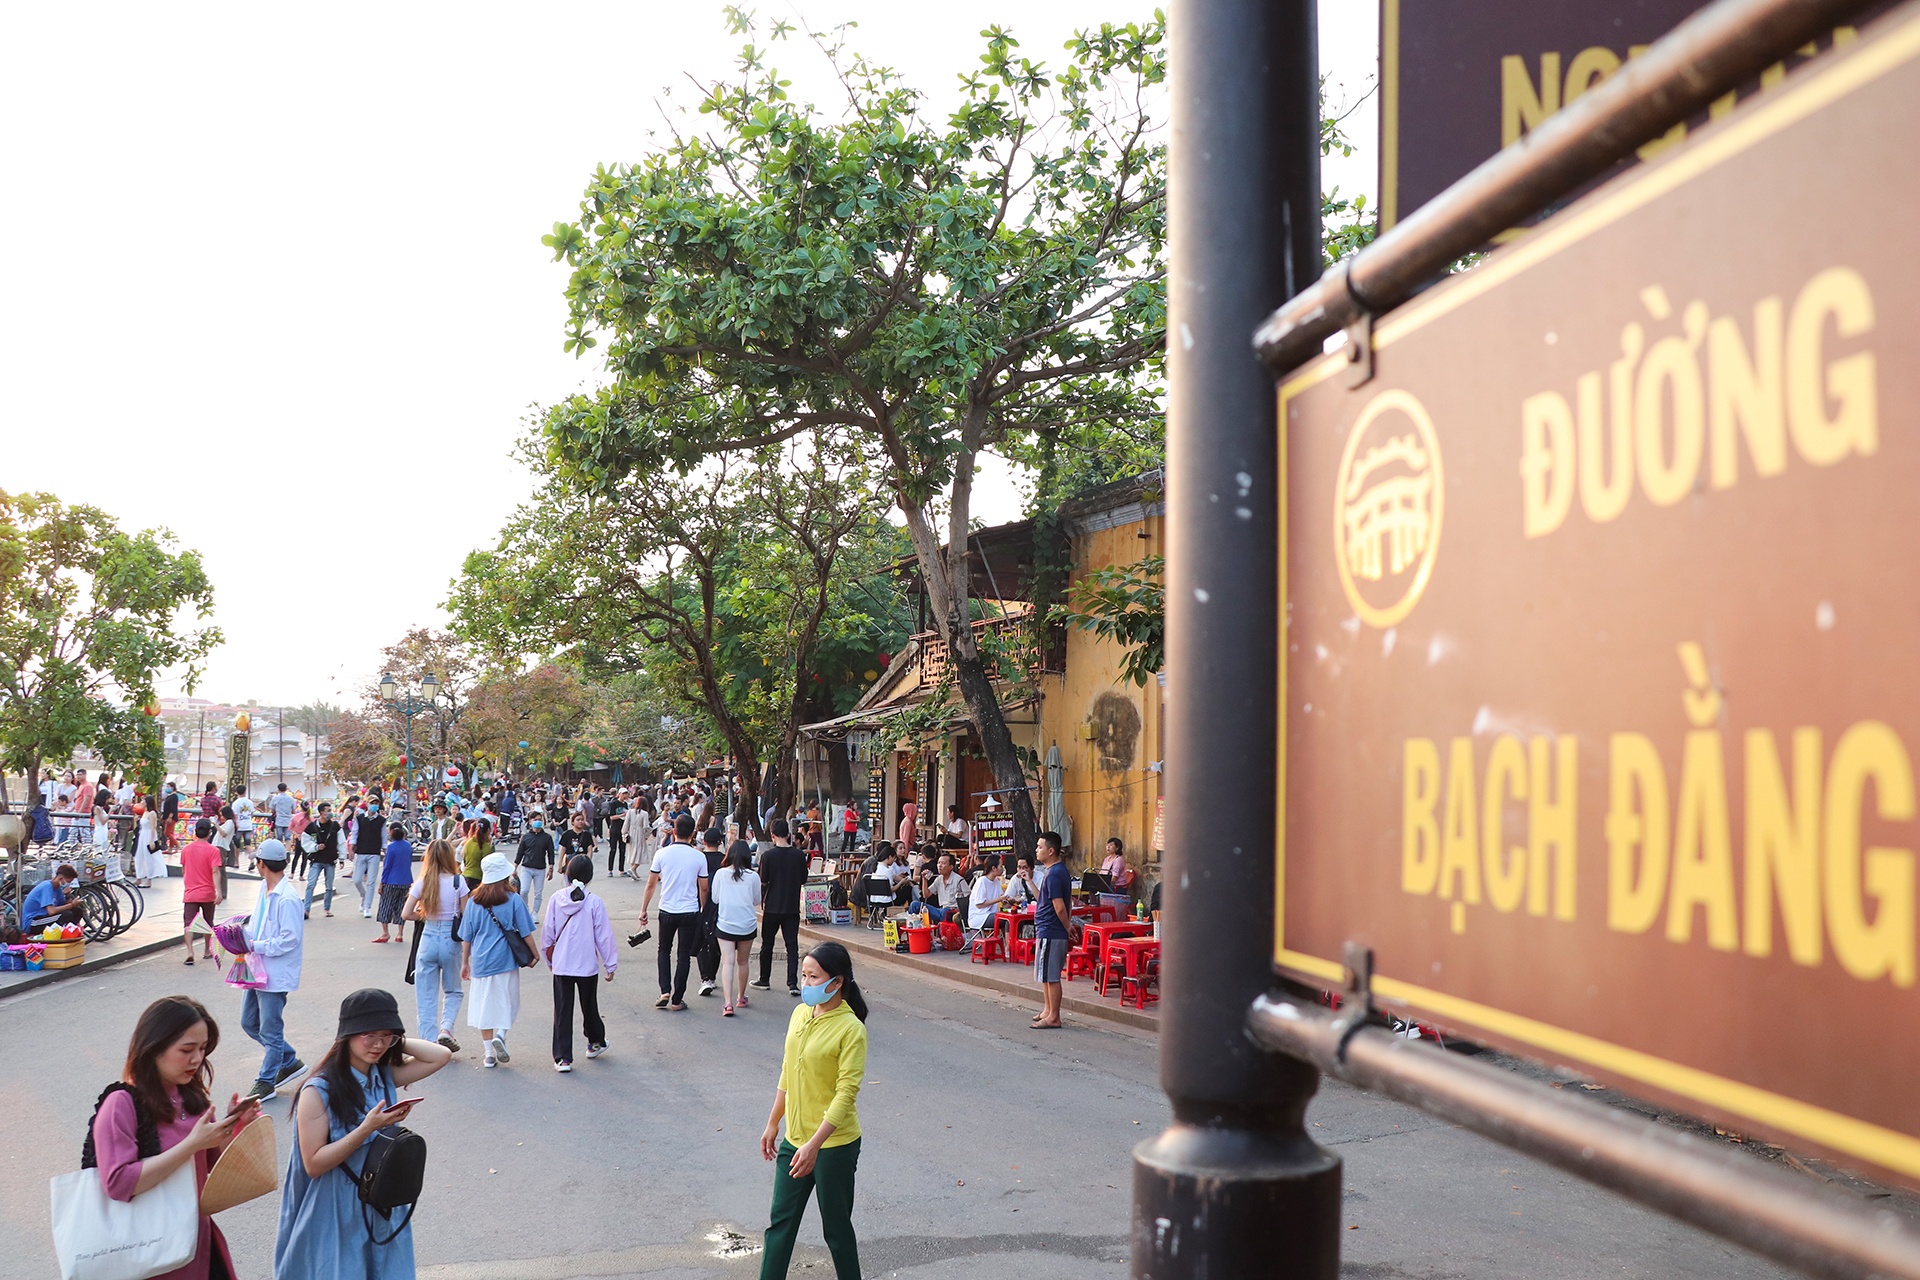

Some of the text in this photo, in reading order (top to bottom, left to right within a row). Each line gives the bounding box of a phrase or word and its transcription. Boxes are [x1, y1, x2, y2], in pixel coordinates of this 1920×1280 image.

[1521, 266, 1879, 538] ĐƯỜNG
[978, 821, 991, 830] THỊT
[1401, 641, 1917, 989] BẠCH ĐẰNG
